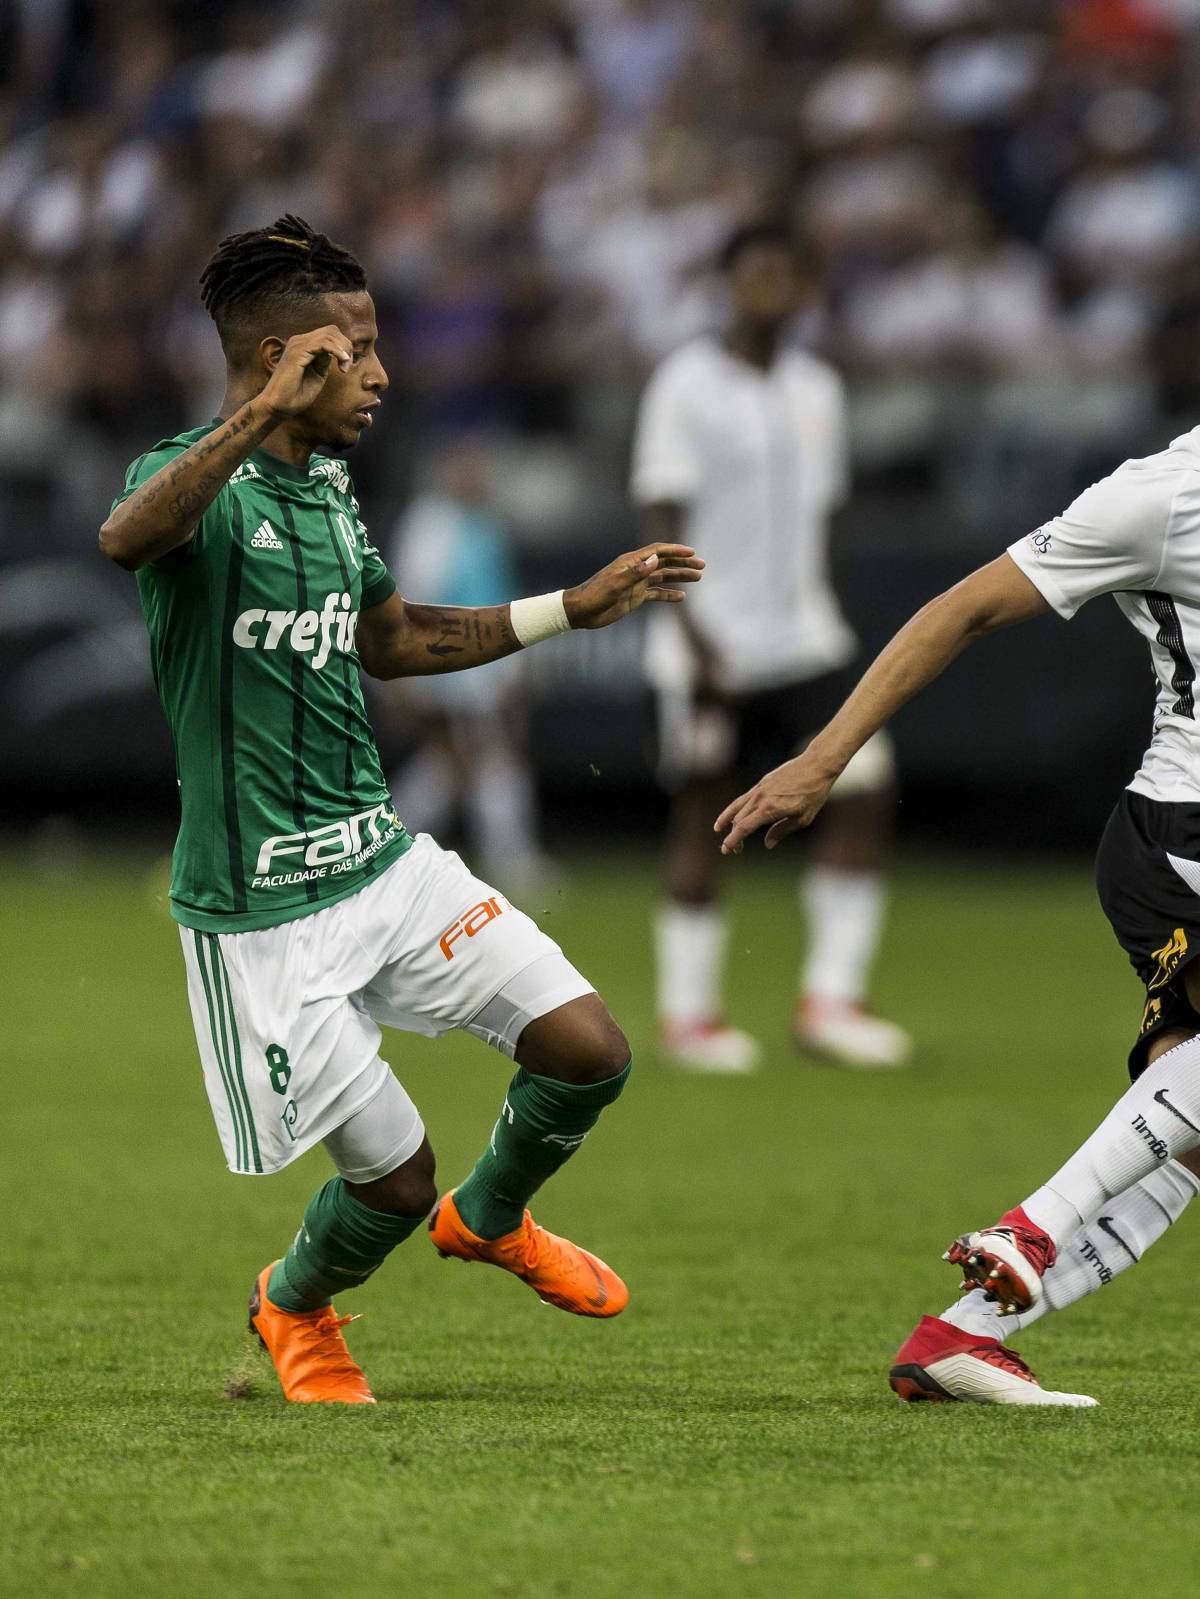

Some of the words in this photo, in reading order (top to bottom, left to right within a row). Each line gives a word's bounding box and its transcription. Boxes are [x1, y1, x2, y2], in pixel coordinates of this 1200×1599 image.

[250, 537, 283, 549] adidas
[251, 866, 327, 888] FACULDADE
[331, 858, 353, 875] DAS
[355, 827, 396, 866] AMERICAS
[265, 1043, 292, 1096] 8
